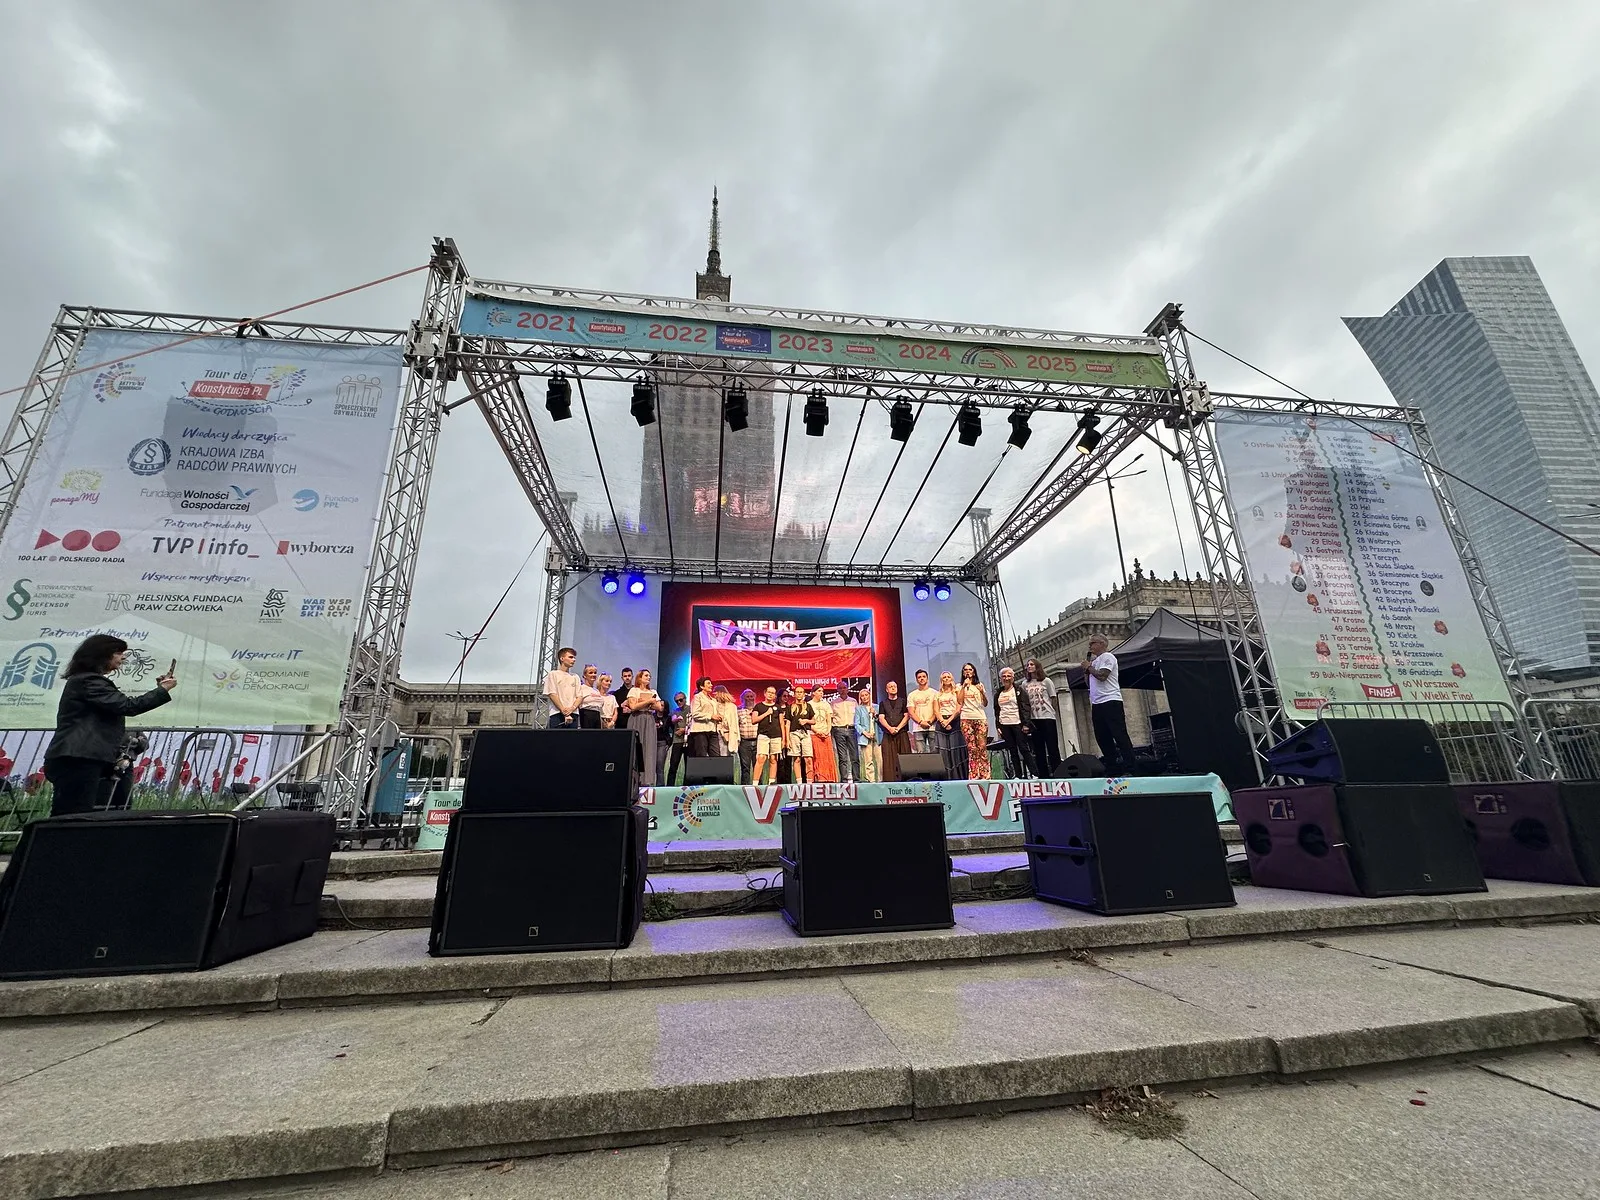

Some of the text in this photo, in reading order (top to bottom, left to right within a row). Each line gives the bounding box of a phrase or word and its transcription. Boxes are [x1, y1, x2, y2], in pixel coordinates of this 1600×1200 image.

[517, 312, 576, 332] 2021
[649, 324, 707, 343] 2022
[778, 333, 833, 353] 2023
[899, 343, 951, 361] 2024
[1026, 355, 1077, 372] 2025
[204, 370, 247, 380] Tour de
[195, 383, 263, 396] Konstytucja PL
[180, 446, 265, 459] KRAJOWA IZBA
[177, 459, 297, 474] RADCÓW PRAWNYCH
[183, 489, 230, 500] Wolności
[181, 500, 250, 512] Gospodarczej
[153, 536, 194, 554] TVP
[290, 542, 354, 555] wyborcza
[141, 572, 187, 582] Wsparcie
[193, 595, 243, 603] FUNDACJA
[165, 604, 223, 612] CZŁOWIEKA
[737, 620, 797, 632] WIELKI
[40, 627, 93, 638] Patronat
[710, 623, 869, 649] PARCZEW
[1332, 634, 1371, 643] Tarnobrzeg
[231, 649, 303, 660] Wsparcie IT
[796, 662, 823, 670] Tour de
[1322, 672, 1382, 680] Buk-Niepruszewo
[1413, 680, 1459, 689] Warszawa
[1367, 687, 1396, 697] FINISH
[1411, 691, 1474, 700] V Wielki Finał
[903, 787, 912, 795] de
[434, 799, 462, 807] Tour de
[743, 783, 858, 824] V WIELKI
[968, 781, 1072, 821] V WIELKI
